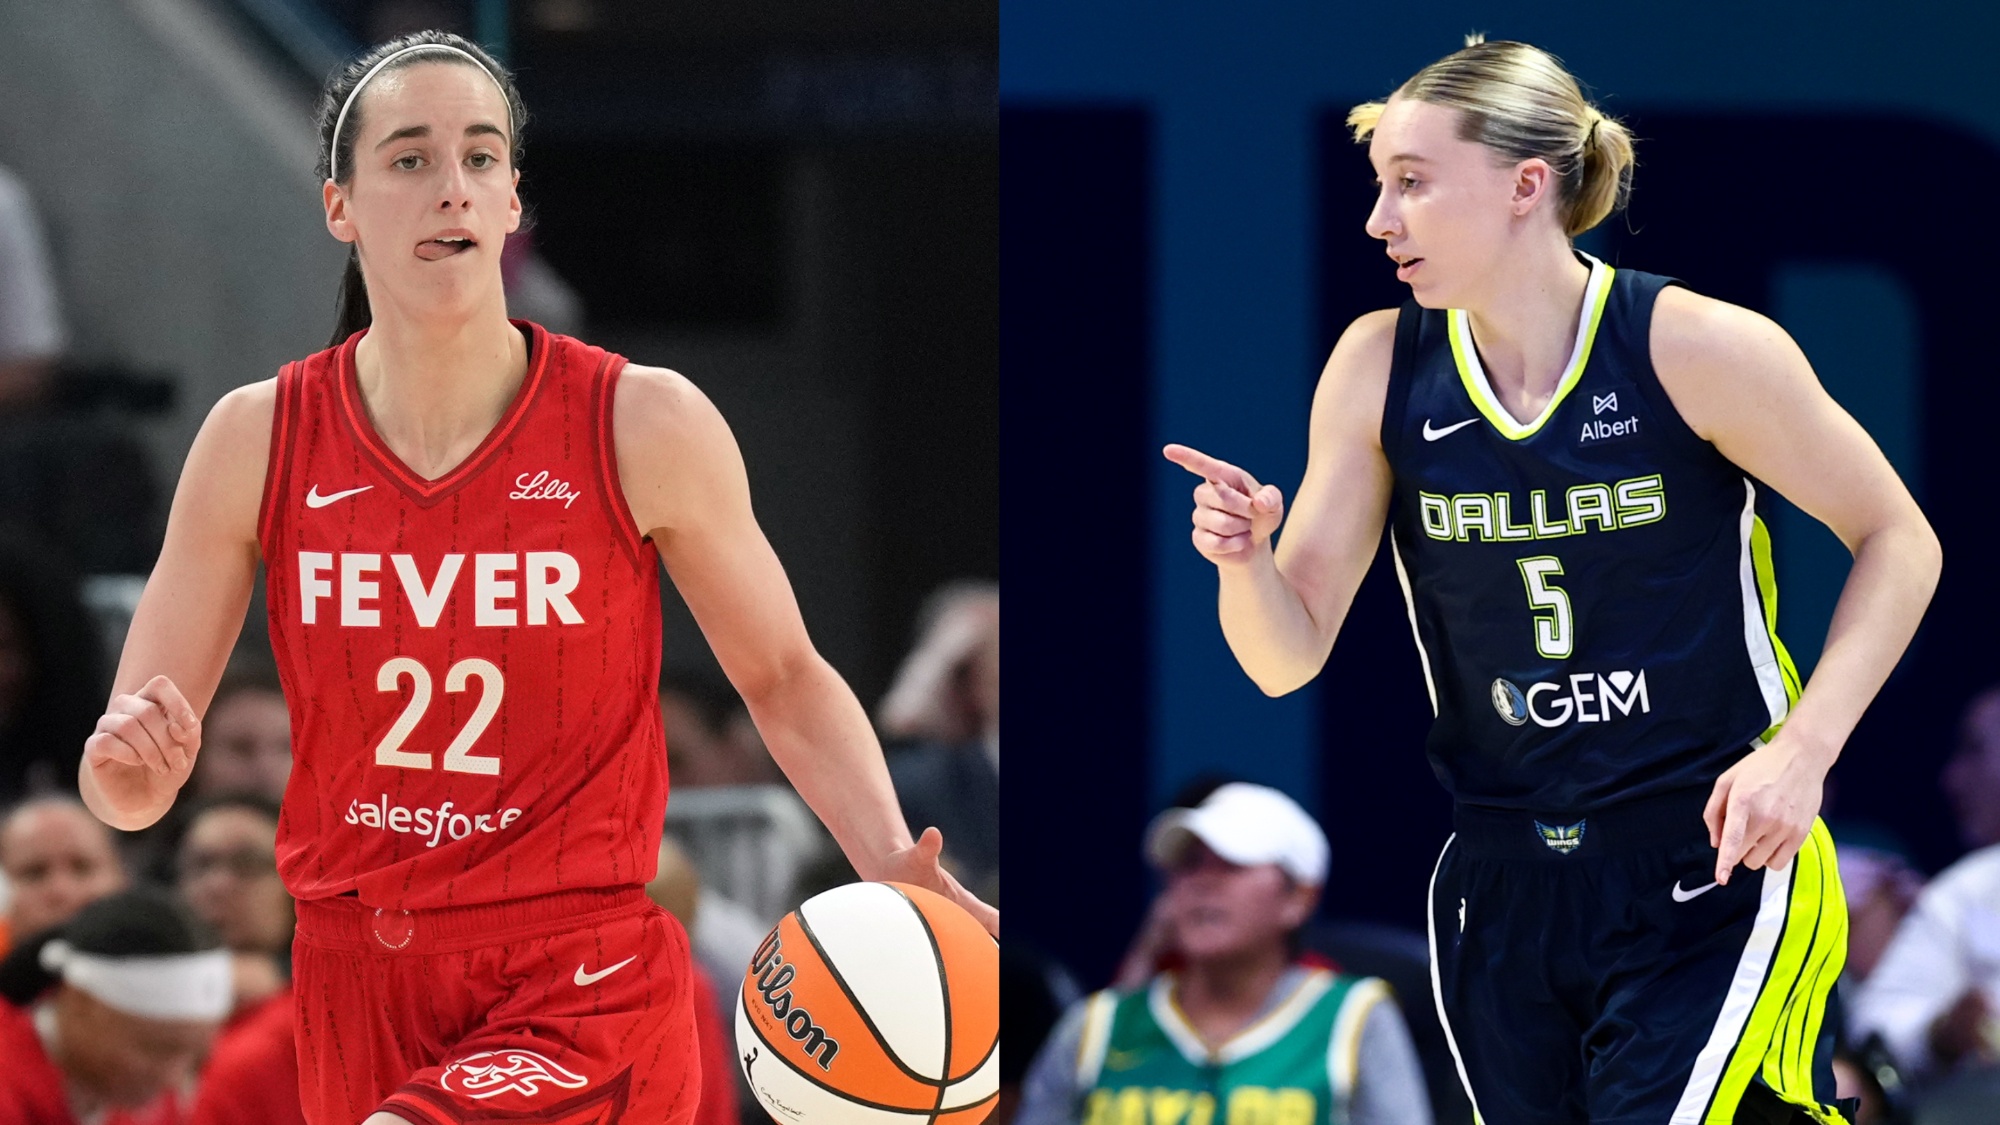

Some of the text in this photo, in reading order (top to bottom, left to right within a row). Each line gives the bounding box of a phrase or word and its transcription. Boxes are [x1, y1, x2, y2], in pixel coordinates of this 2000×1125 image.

[1580, 415, 1639, 442] Albert
[508, 470, 581, 509] Lilly
[1418, 473, 1667, 542] DALLAS
[297, 551, 586, 628] FEVER
[1515, 555, 1574, 660] 5
[374, 657, 505, 776] 22
[1526, 667, 1651, 728] GEM
[344, 794, 523, 848] salesforce
[751, 923, 840, 1072] Wilson
